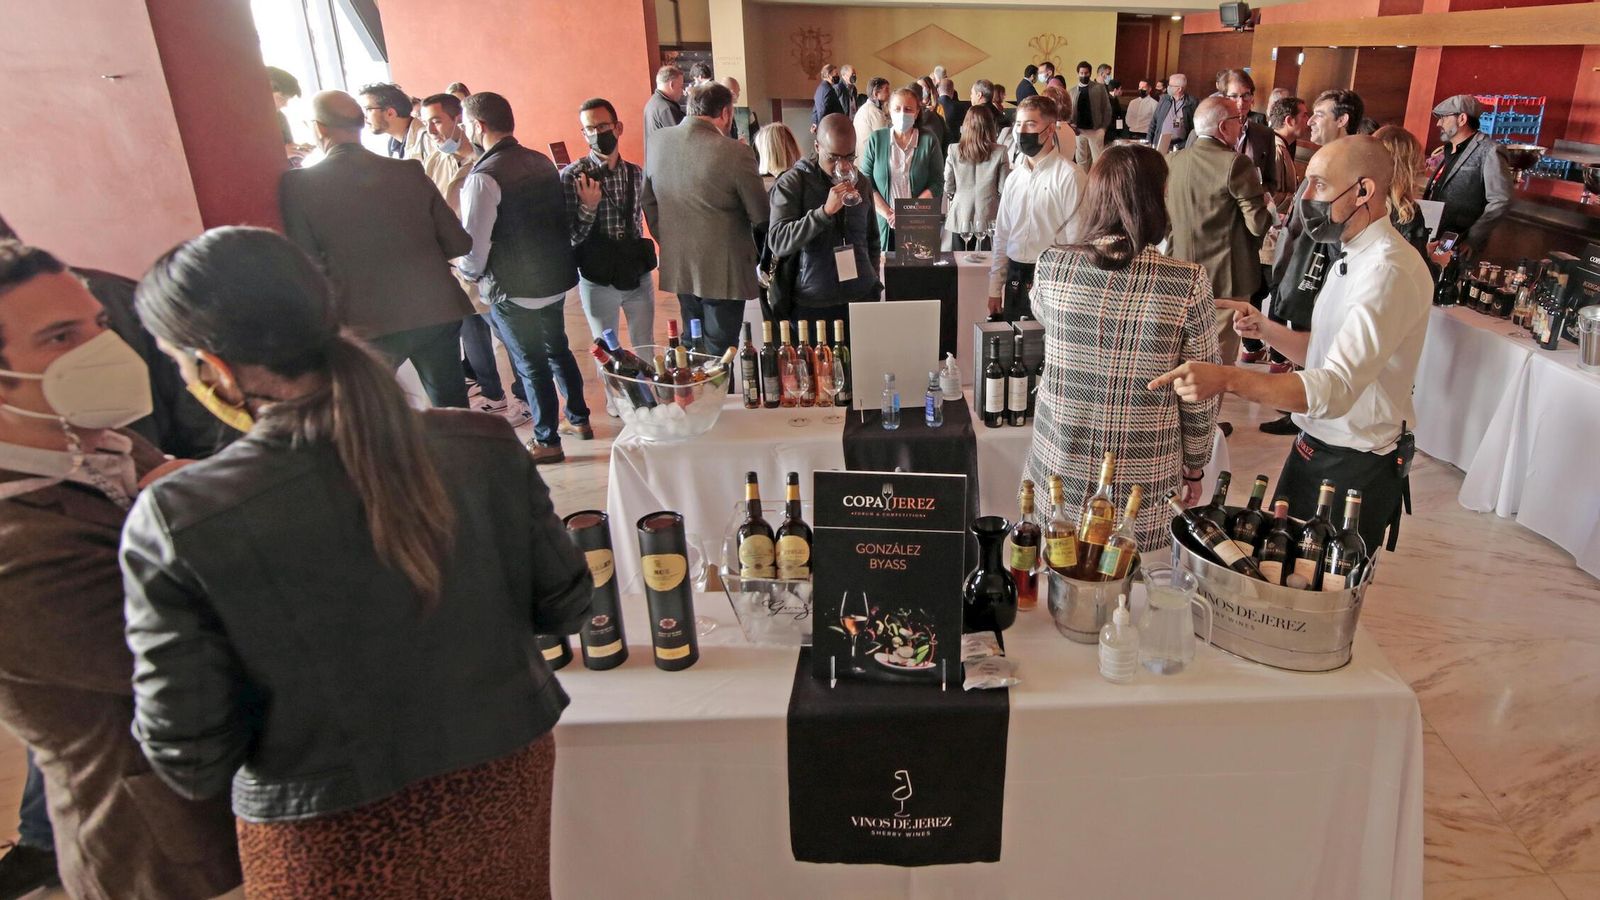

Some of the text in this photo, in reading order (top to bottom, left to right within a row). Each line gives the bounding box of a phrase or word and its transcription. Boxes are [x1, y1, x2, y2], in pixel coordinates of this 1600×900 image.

[843, 495, 935, 510] COPA JEREZ
[855, 542, 921, 556] GONZÁLEZ
[870, 558, 907, 570] BYASS
[1236, 605, 1257, 620] DE
[1257, 613, 1306, 633] JEREZ
[851, 816, 952, 829] VINOS DE JEREZ
